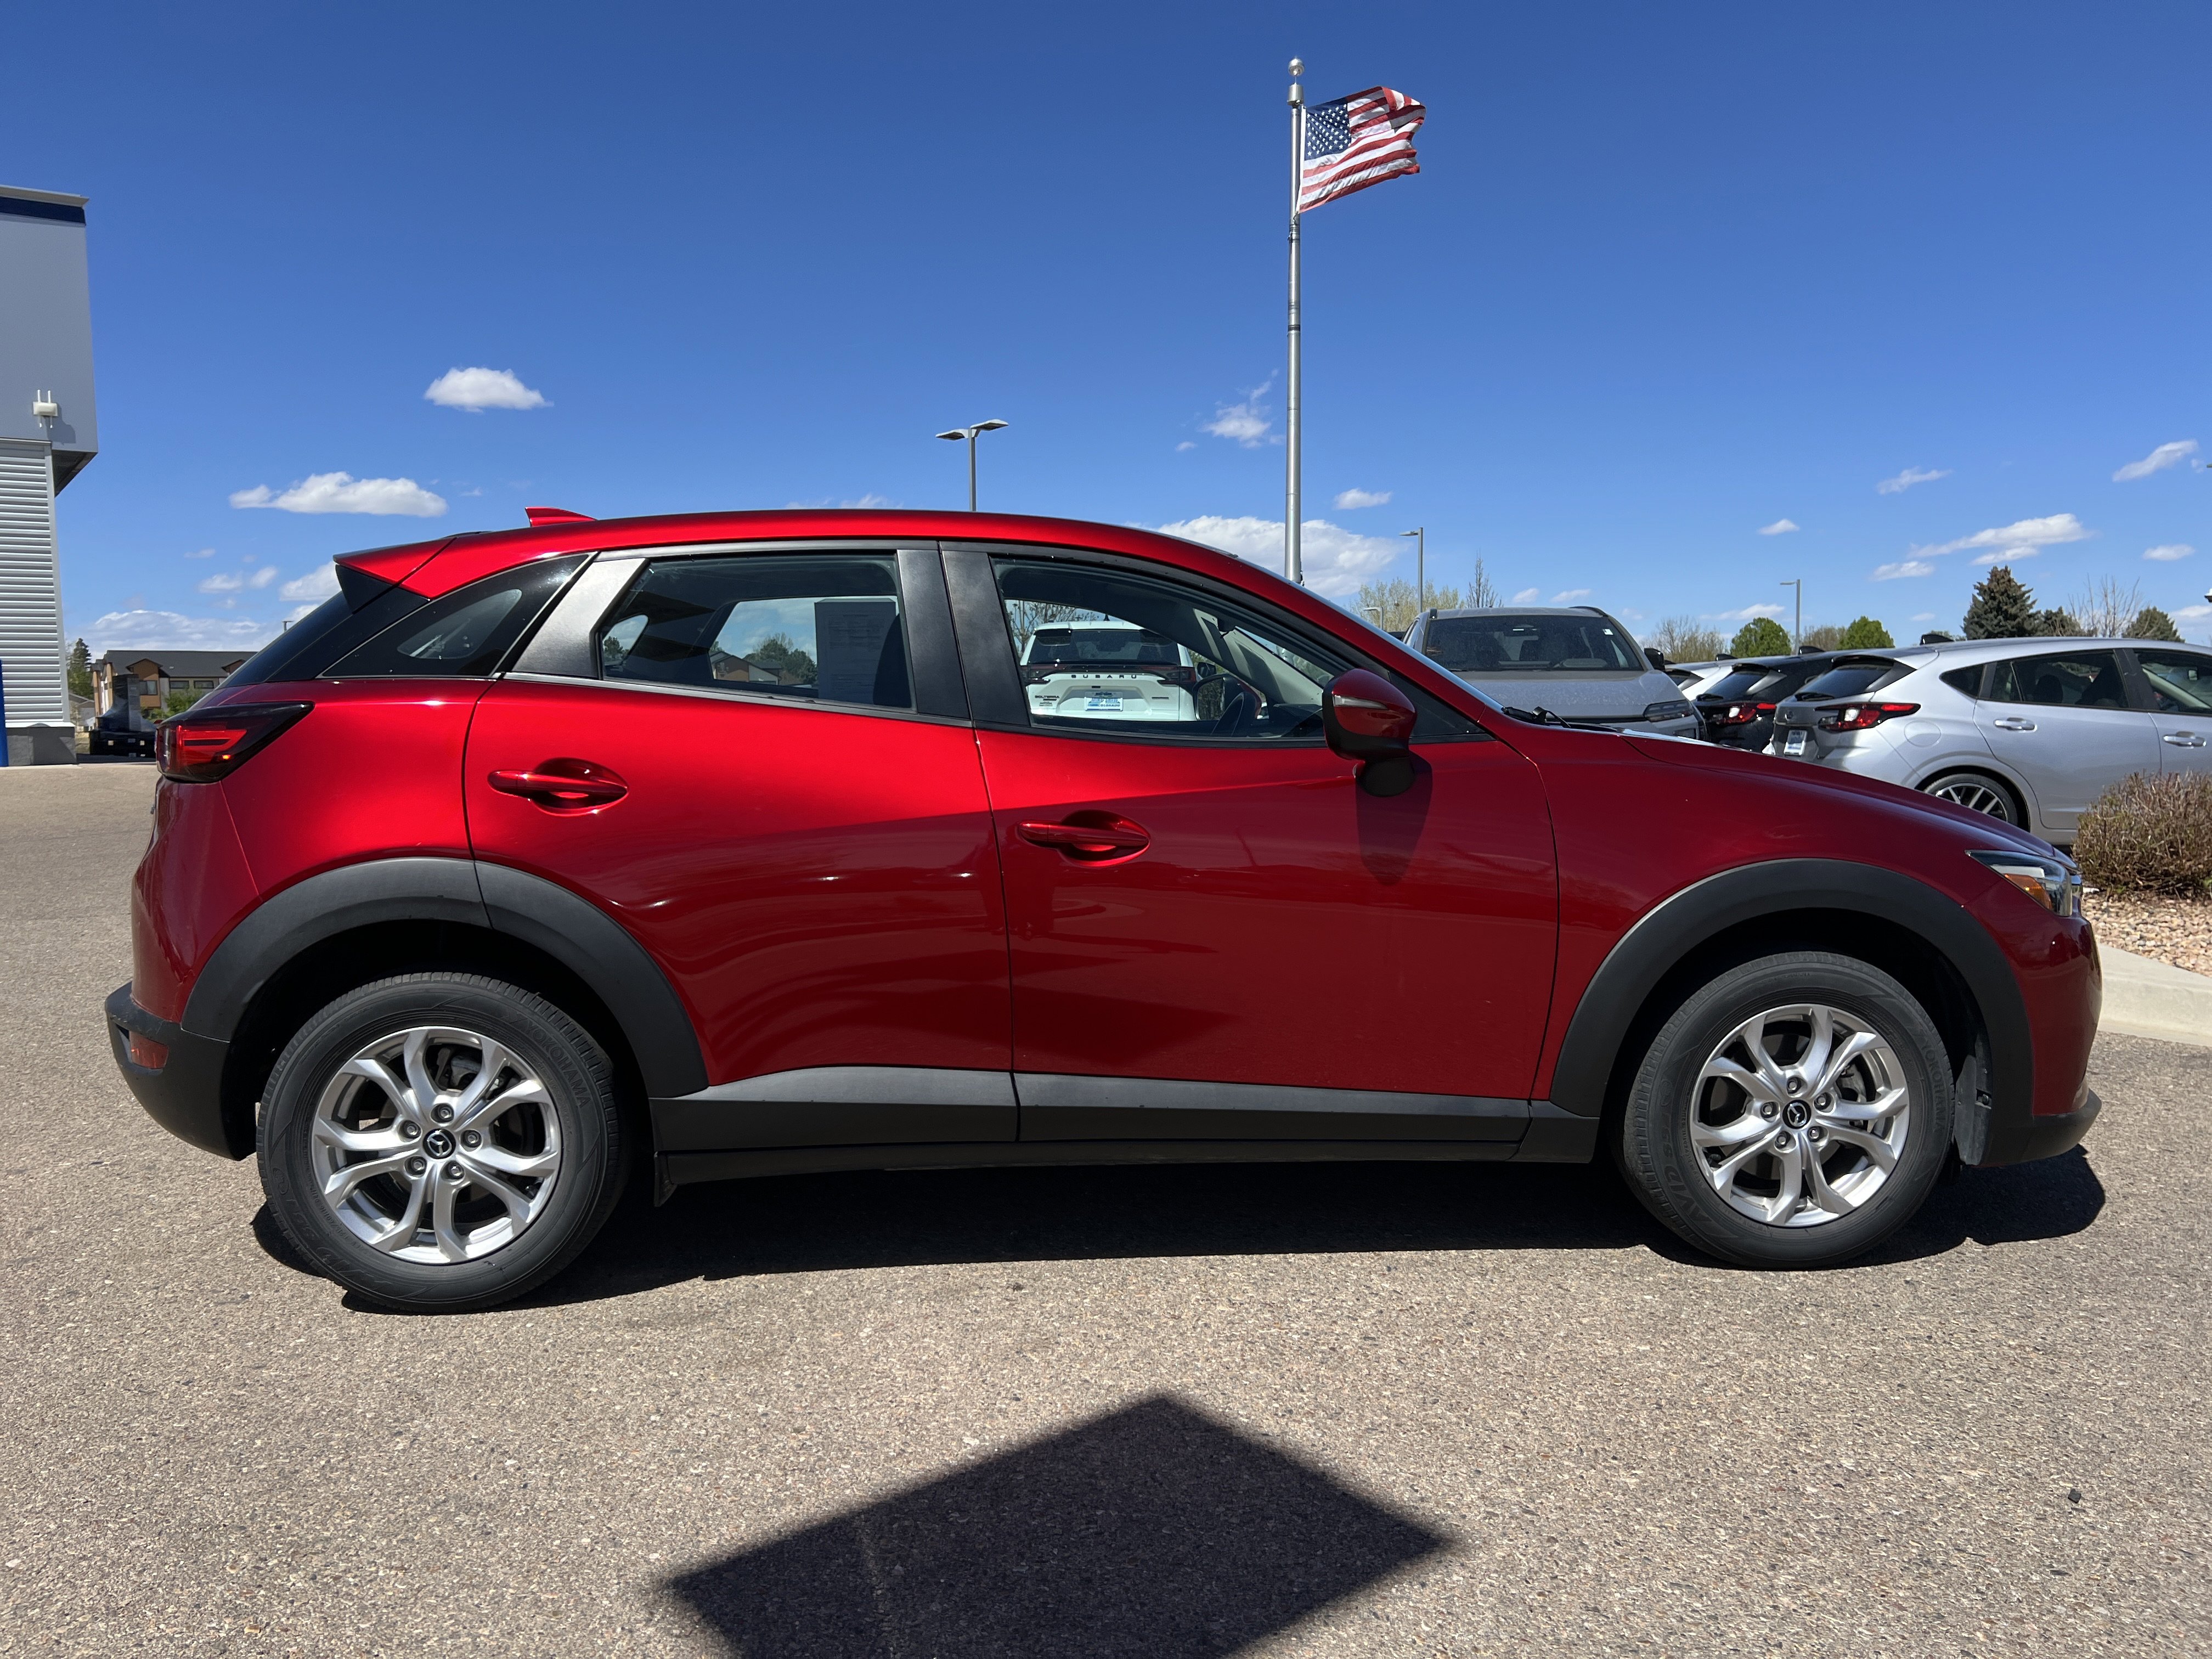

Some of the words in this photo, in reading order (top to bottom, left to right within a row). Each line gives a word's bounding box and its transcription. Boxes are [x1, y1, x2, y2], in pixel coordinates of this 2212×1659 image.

[525, 1018, 591, 1108] YOKOHAMA
[1921, 1040, 1946, 1133] YOKOHAMA
[1664, 1165, 1712, 1222] AVID
